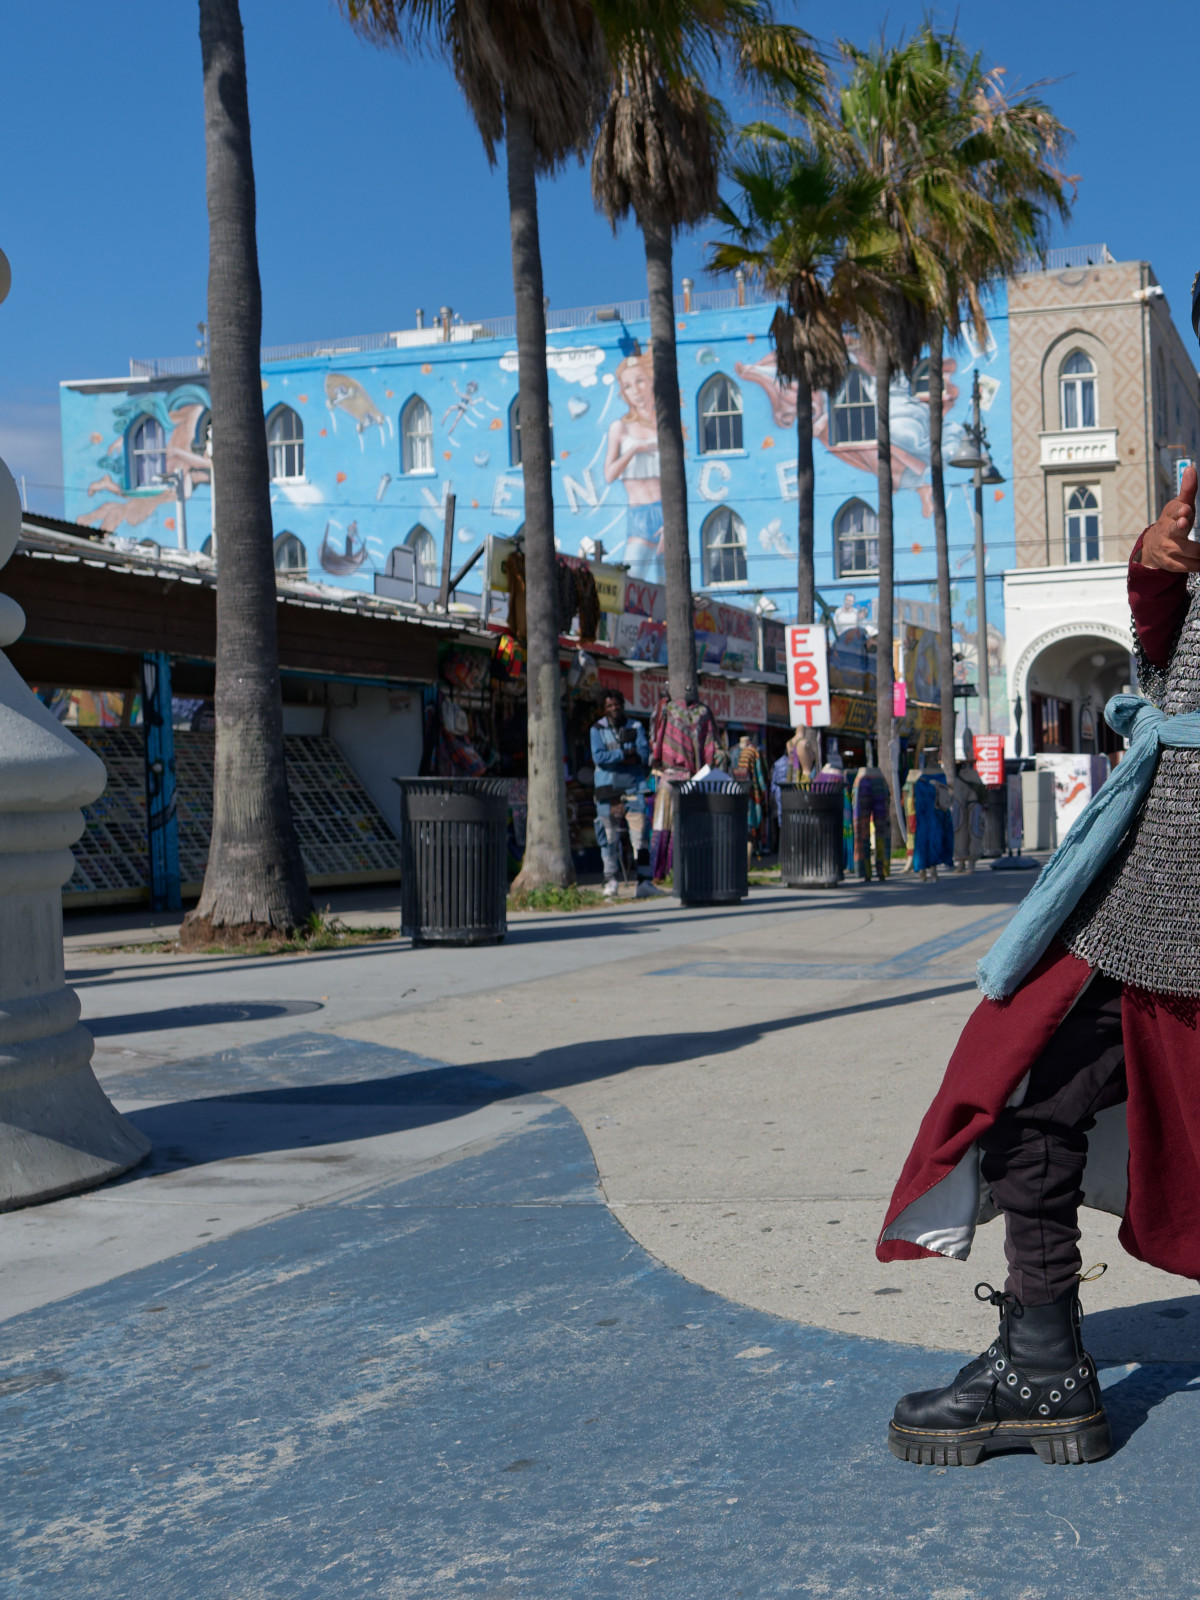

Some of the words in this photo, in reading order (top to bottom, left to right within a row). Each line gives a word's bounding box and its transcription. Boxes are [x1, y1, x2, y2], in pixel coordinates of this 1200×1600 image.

[421, 460, 799, 520] VENCE
[625, 582, 659, 617] CKY
[791, 628, 822, 727] EBT
